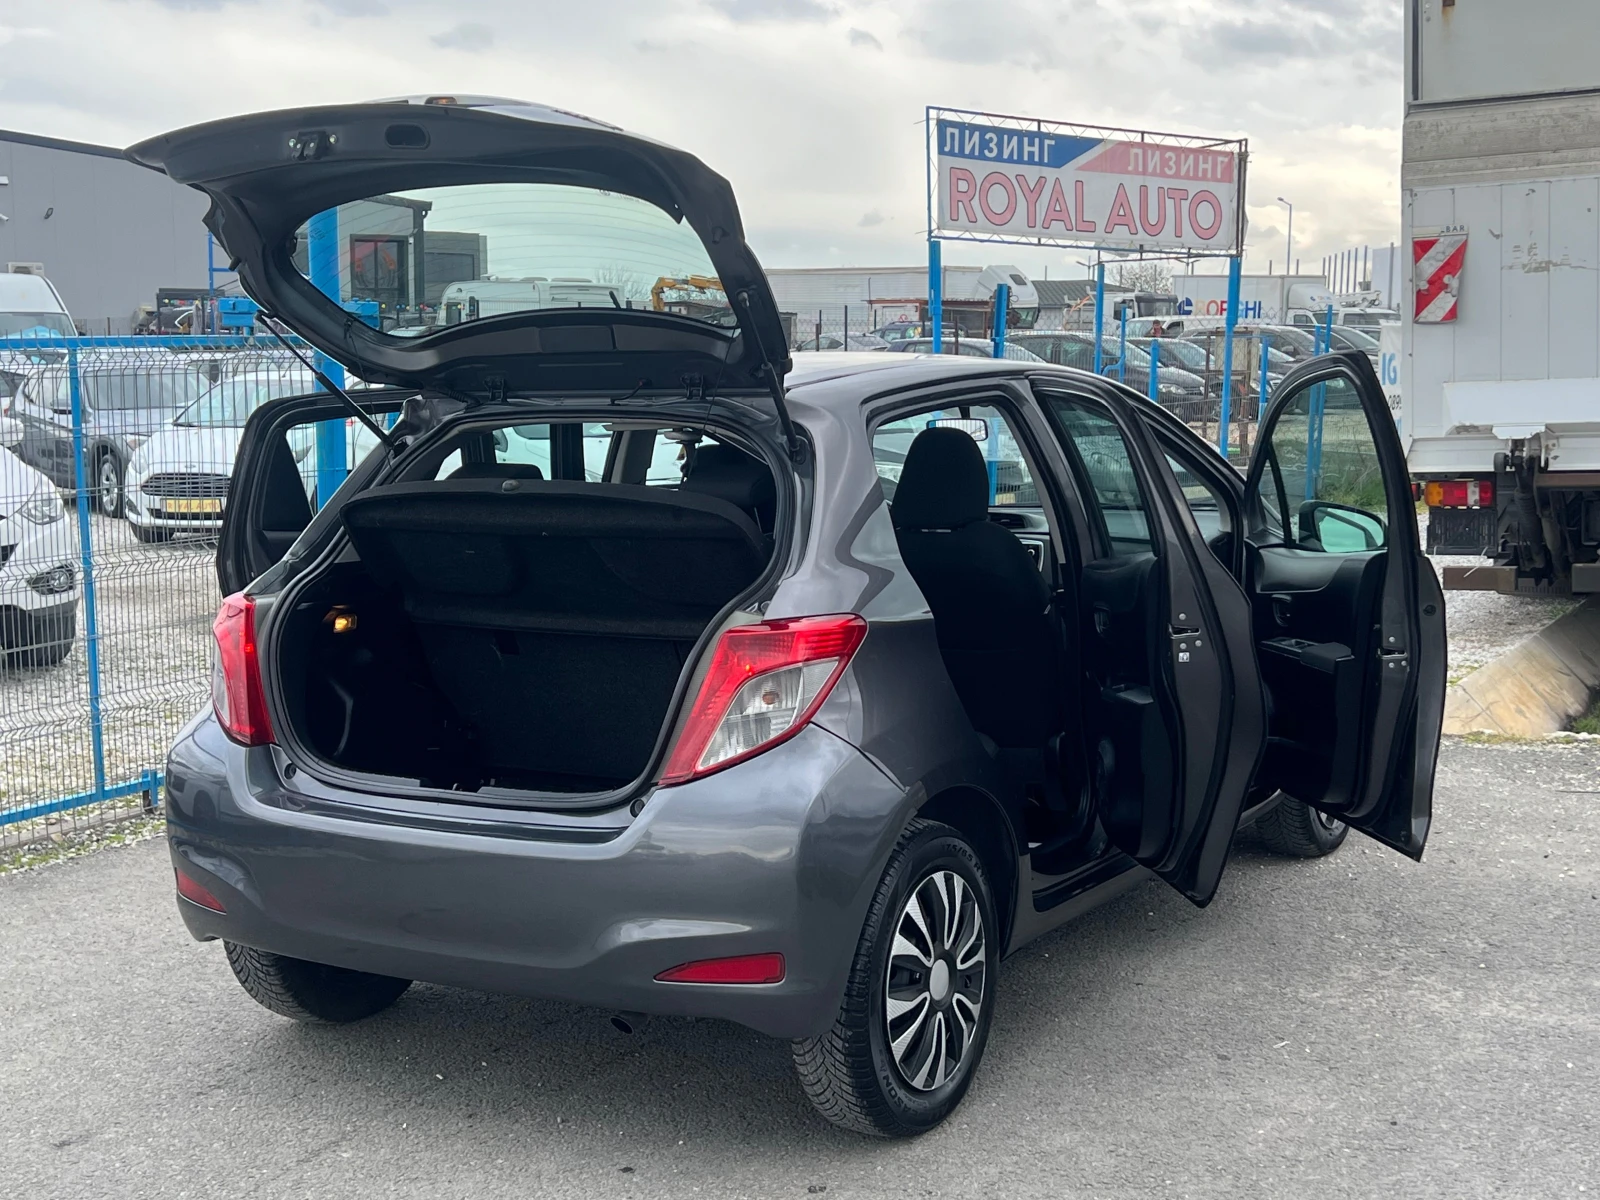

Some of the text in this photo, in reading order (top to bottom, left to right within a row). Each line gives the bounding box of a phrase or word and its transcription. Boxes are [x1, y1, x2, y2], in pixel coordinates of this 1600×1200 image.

[944, 127, 1055, 163] ЛИЗИНГ
[1127, 148, 1229, 179] ЛИЗИНГ
[950, 166, 1223, 240] ROYAL AUTO
